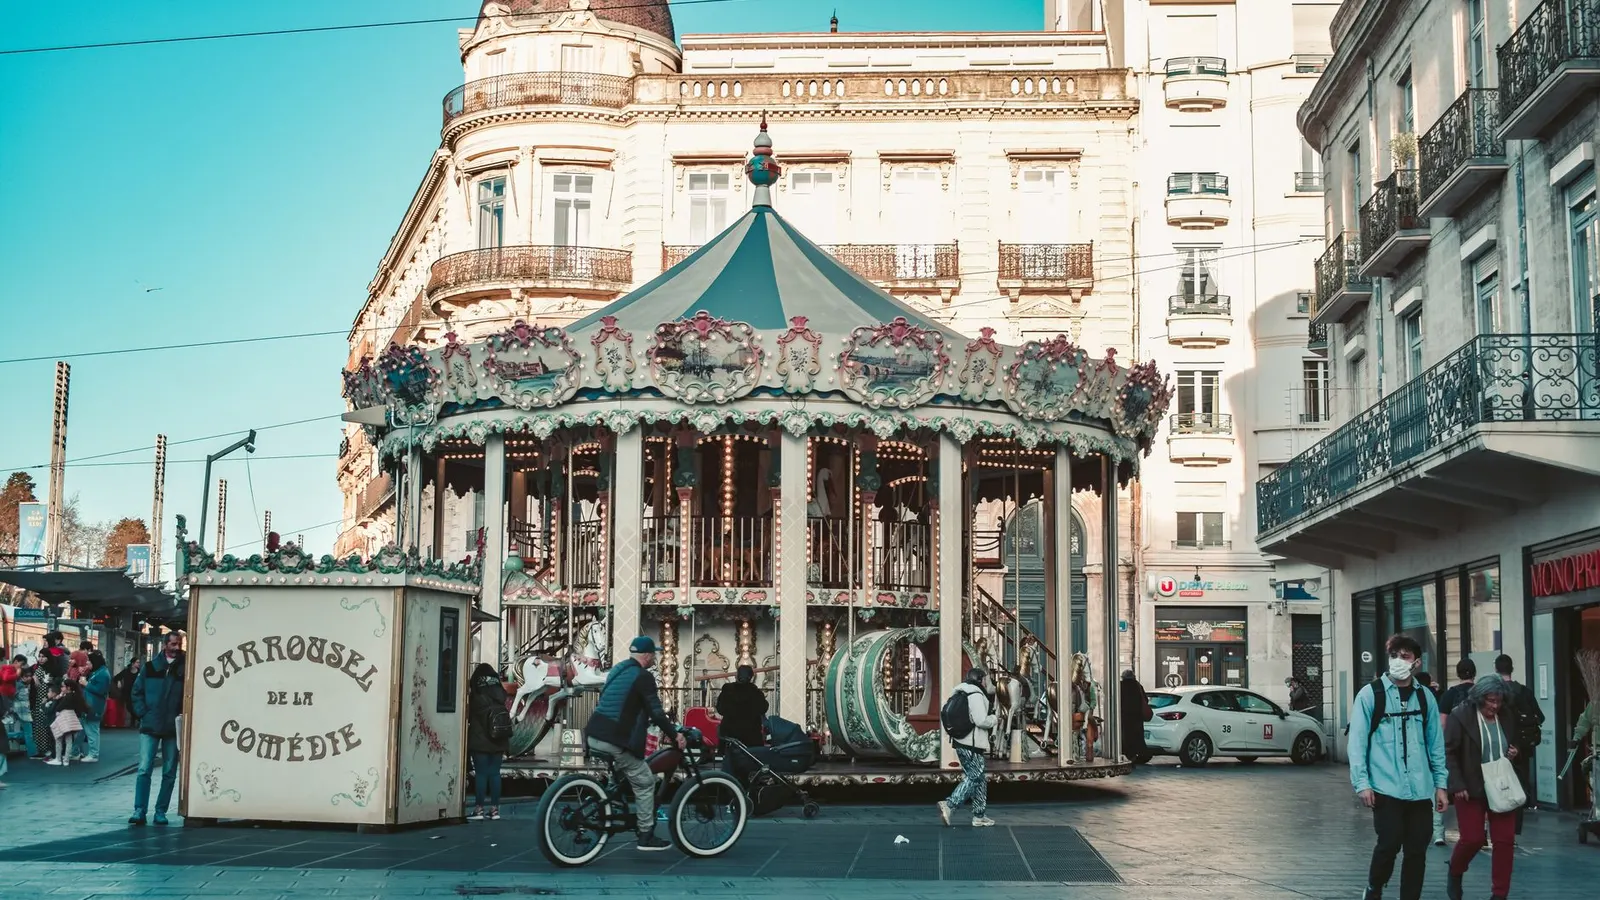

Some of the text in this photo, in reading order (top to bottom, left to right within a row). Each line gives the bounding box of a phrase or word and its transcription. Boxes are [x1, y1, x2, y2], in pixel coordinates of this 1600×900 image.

[1530, 549, 1600, 597] MONOPRI
[1161, 581, 1172, 592] U
[1179, 582, 1214, 590] DRIVE
[202, 634, 379, 693] CARROUSEL
[267, 691, 314, 706] DE LA
[1222, 725, 1232, 733] 38
[1265, 725, 1272, 735] N
[220, 719, 363, 762] COMÉDIE
